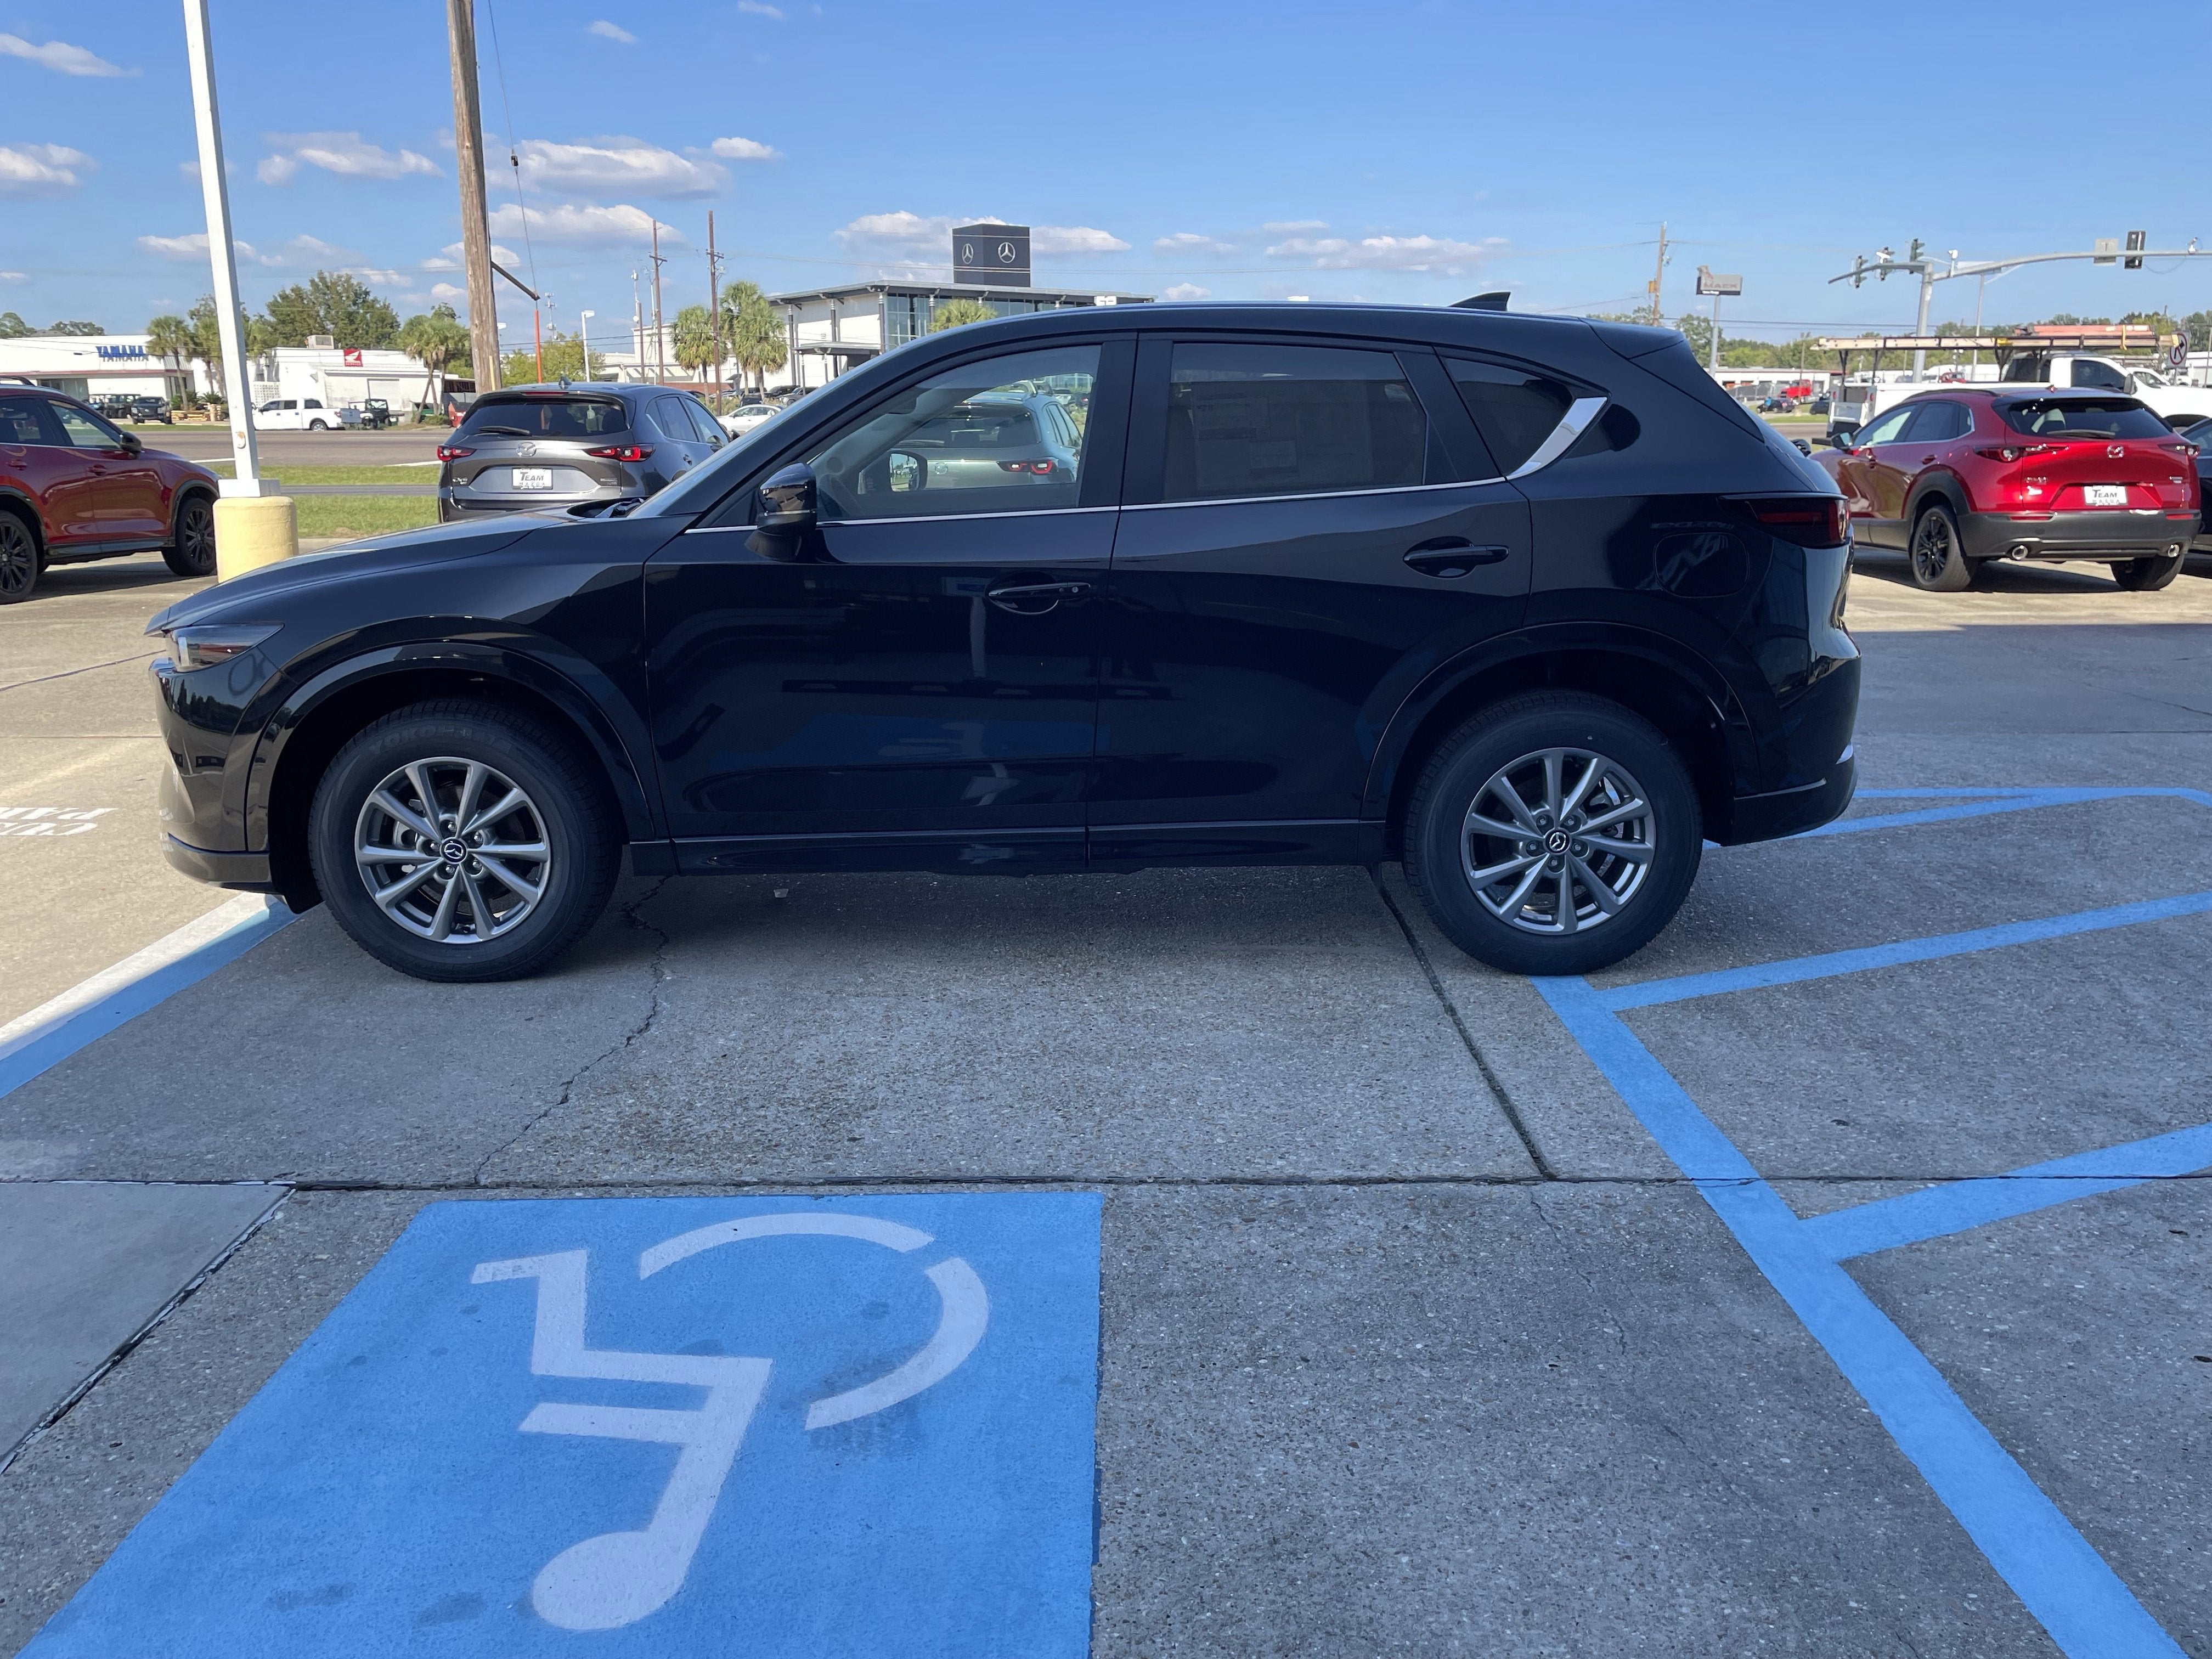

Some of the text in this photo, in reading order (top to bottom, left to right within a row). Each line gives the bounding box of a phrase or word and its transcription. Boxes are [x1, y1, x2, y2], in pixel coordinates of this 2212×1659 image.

[95, 345, 146, 357] YAMAHA
[520, 472, 544, 481] TEAM
[2092, 489, 2117, 498] TEAM
